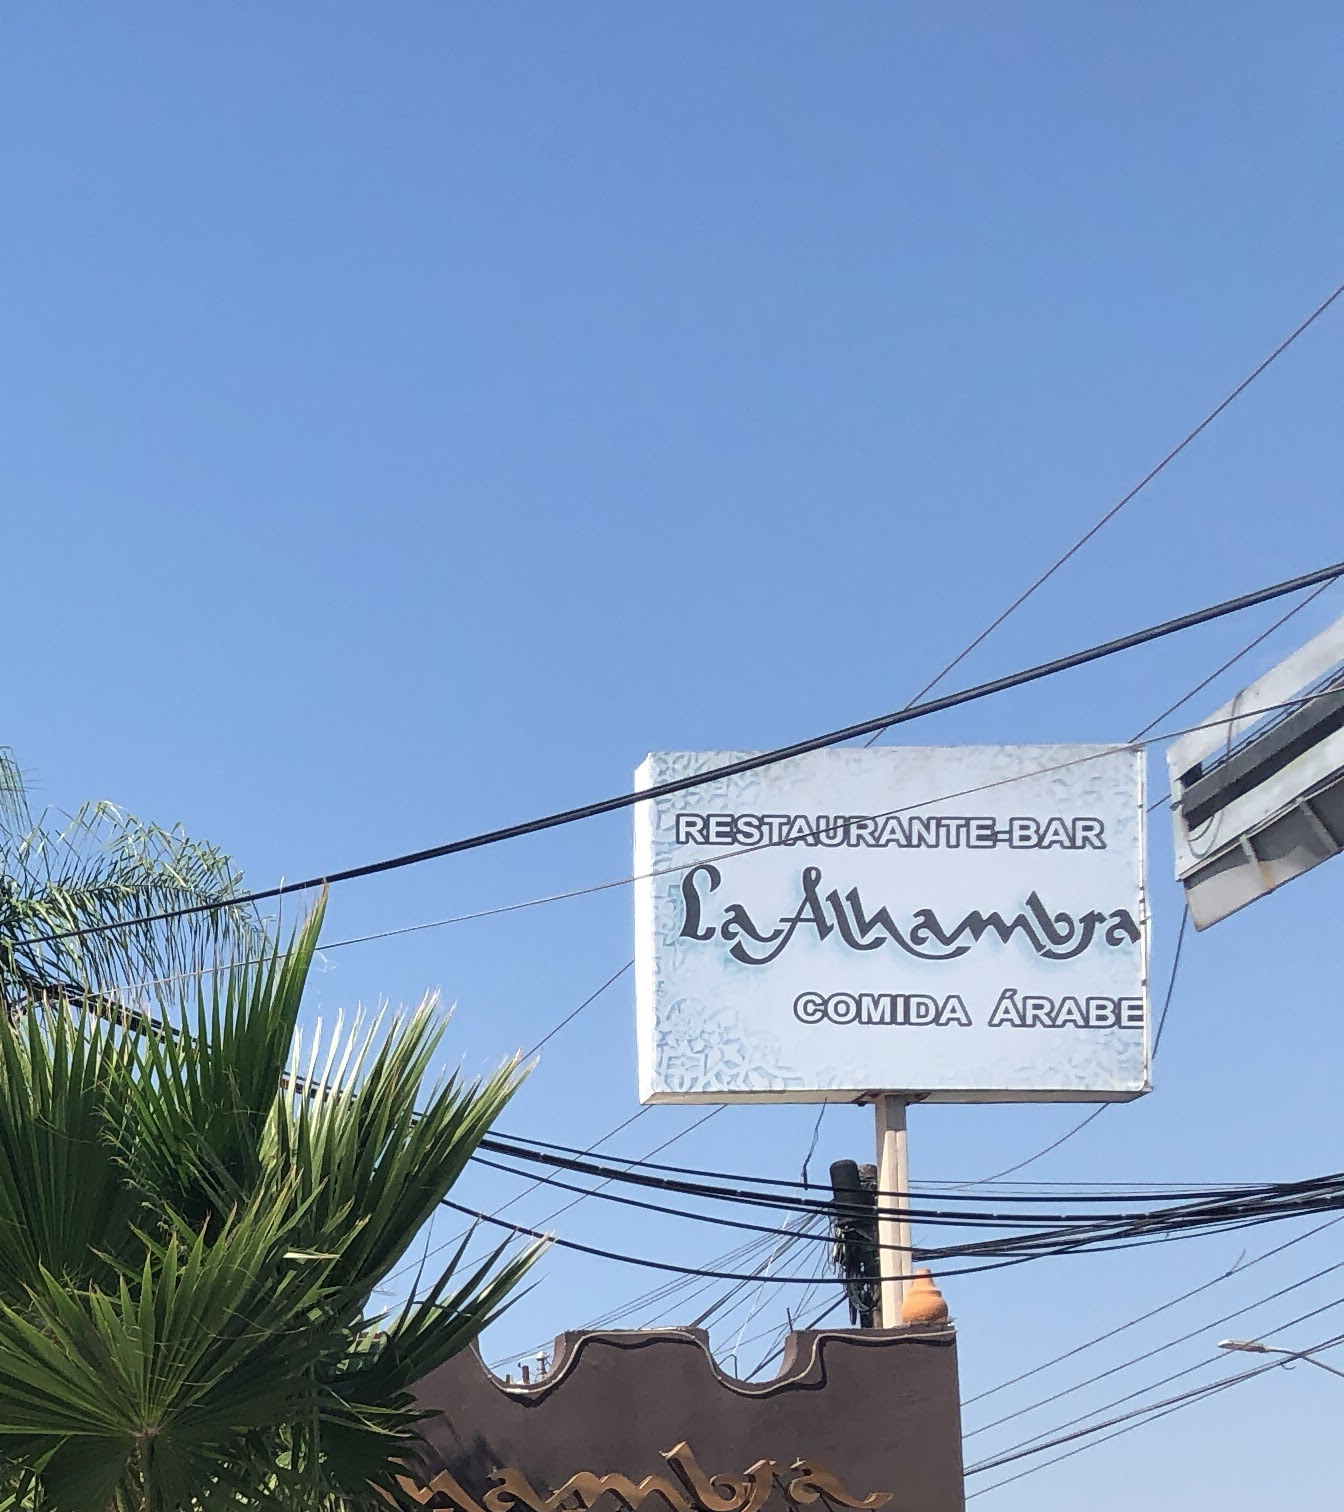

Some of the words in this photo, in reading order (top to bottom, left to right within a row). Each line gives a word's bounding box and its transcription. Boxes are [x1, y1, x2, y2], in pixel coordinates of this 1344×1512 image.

[676, 813, 1107, 849] RESTAURANTE-BAR
[678, 864, 782, 943] La
[729, 866, 1143, 966] Alhambra
[793, 991, 972, 1027] COMIDA
[988, 988, 1144, 1029] ÁRABE
